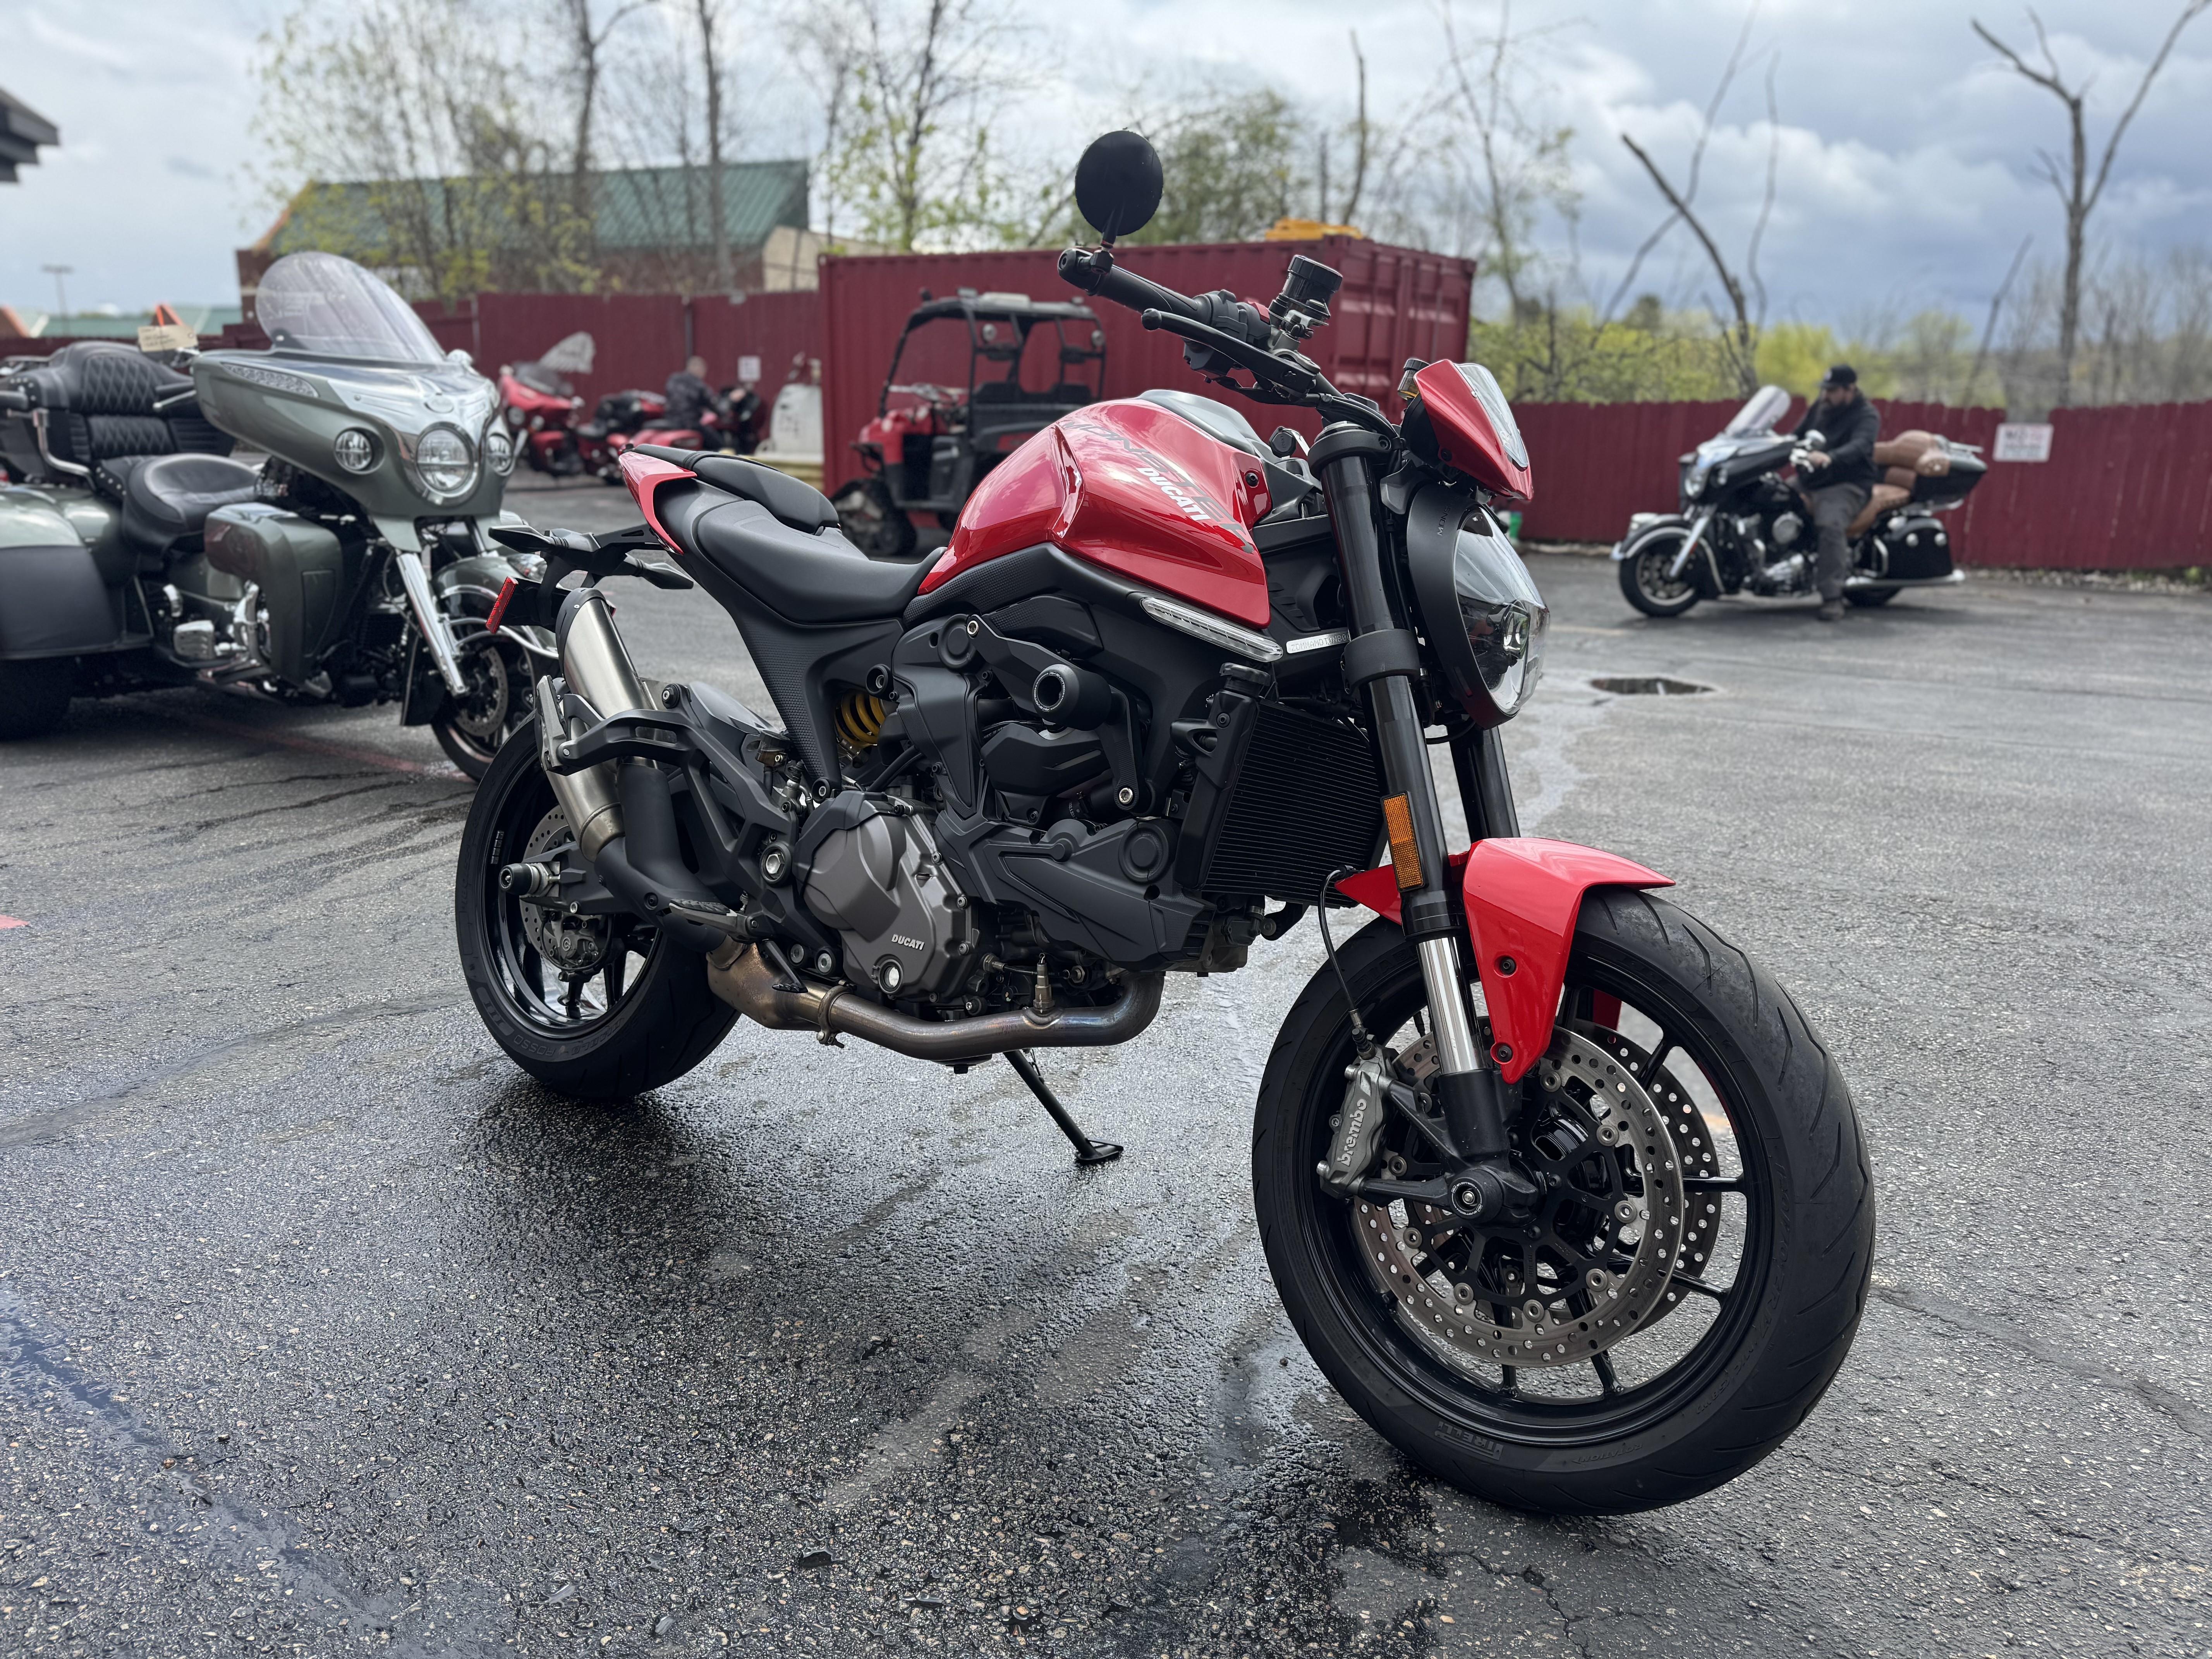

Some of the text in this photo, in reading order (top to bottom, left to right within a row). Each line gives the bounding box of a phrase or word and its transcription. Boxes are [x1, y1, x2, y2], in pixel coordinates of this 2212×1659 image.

[1136, 467, 1213, 520] DUCATI
[891, 934, 925, 950] DUCATI
[1353, 943, 1418, 991] DIAB
[483, 1001, 505, 1026] III
[514, 1034, 556, 1056] ROSSO
[1337, 1099, 1367, 1166] brembo
[1434, 1421, 1504, 1461] PIRELLI
[1580, 1443, 1643, 1462] ROTATION
